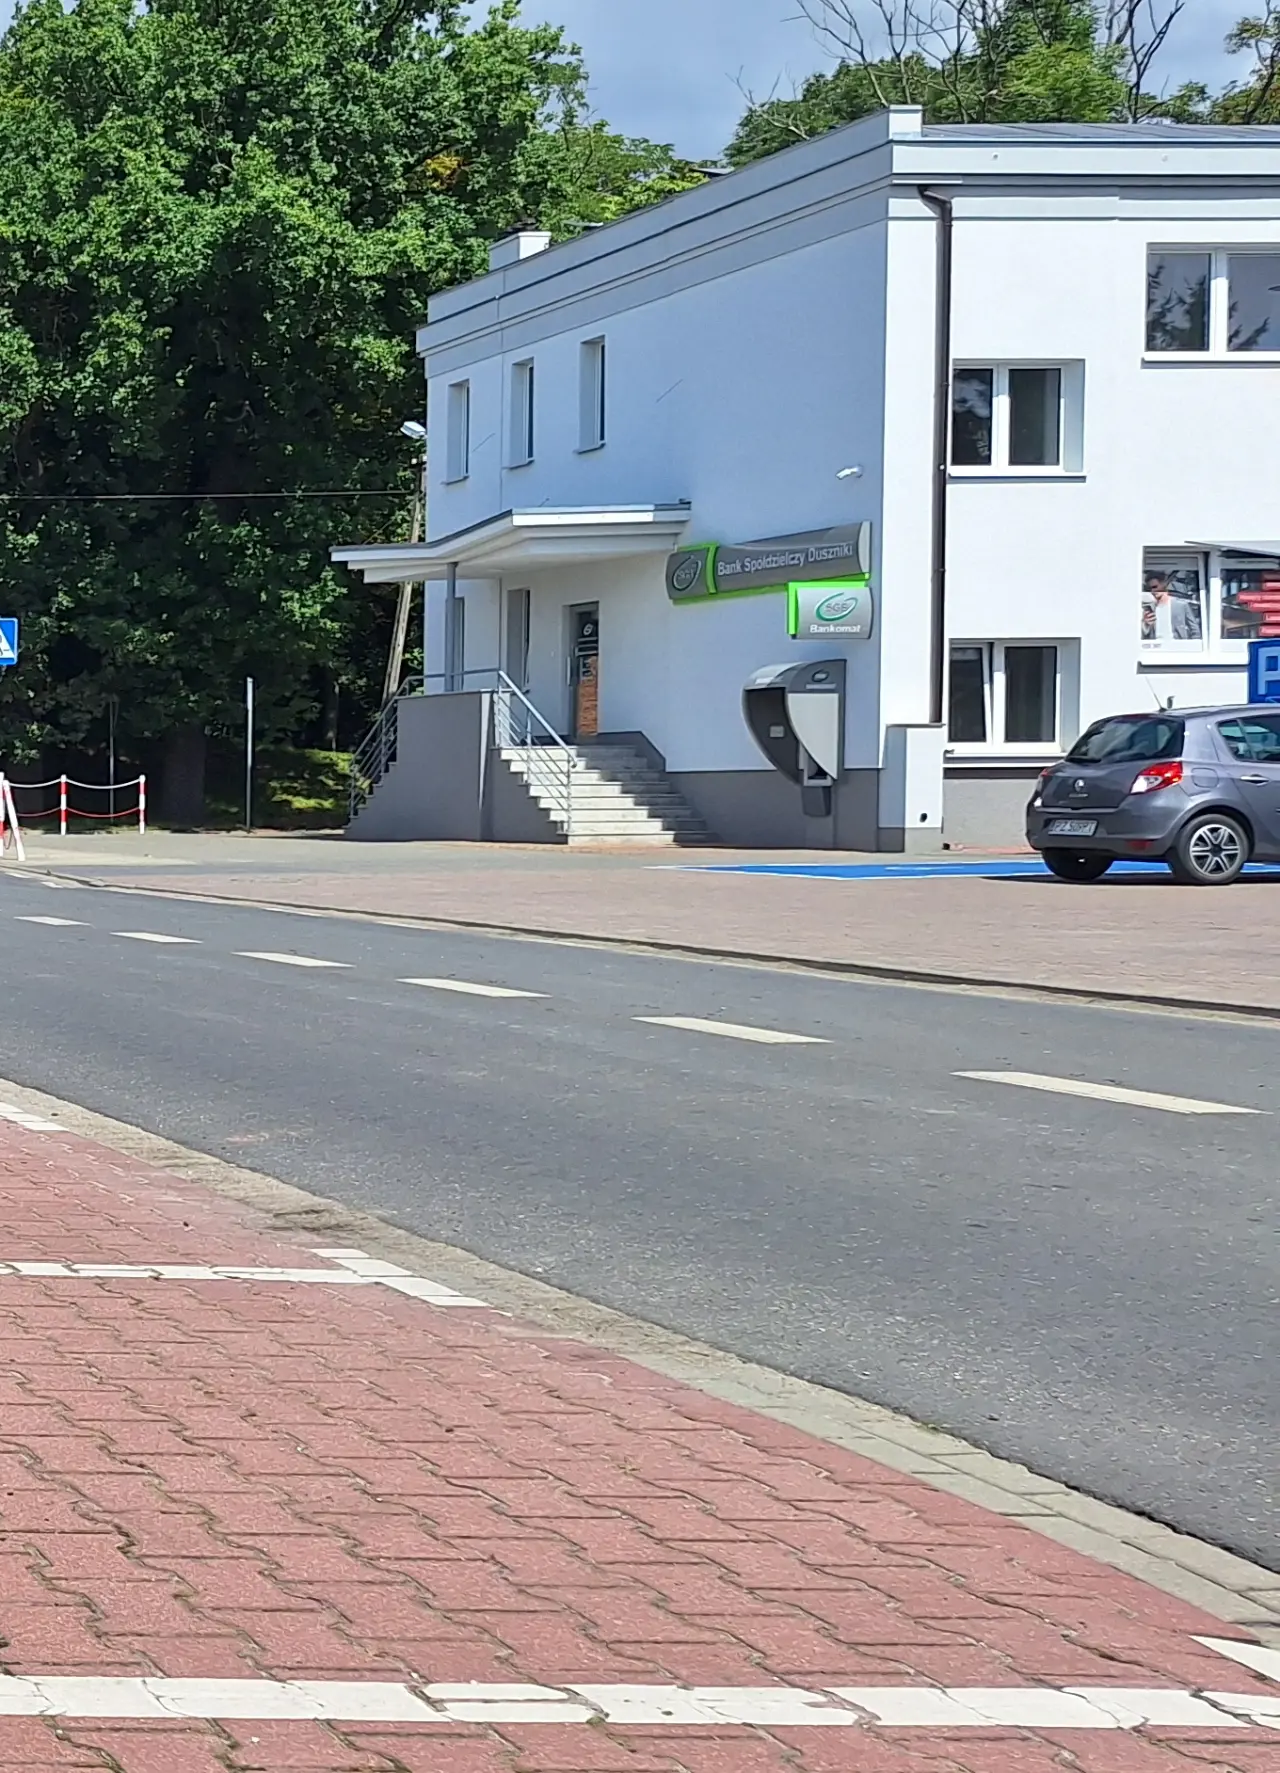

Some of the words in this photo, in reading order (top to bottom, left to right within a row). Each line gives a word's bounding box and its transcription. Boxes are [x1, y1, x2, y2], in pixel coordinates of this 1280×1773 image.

[718, 560, 742, 576] Bank
[807, 544, 853, 562] Duszniki
[809, 624, 861, 633] Bankomat
